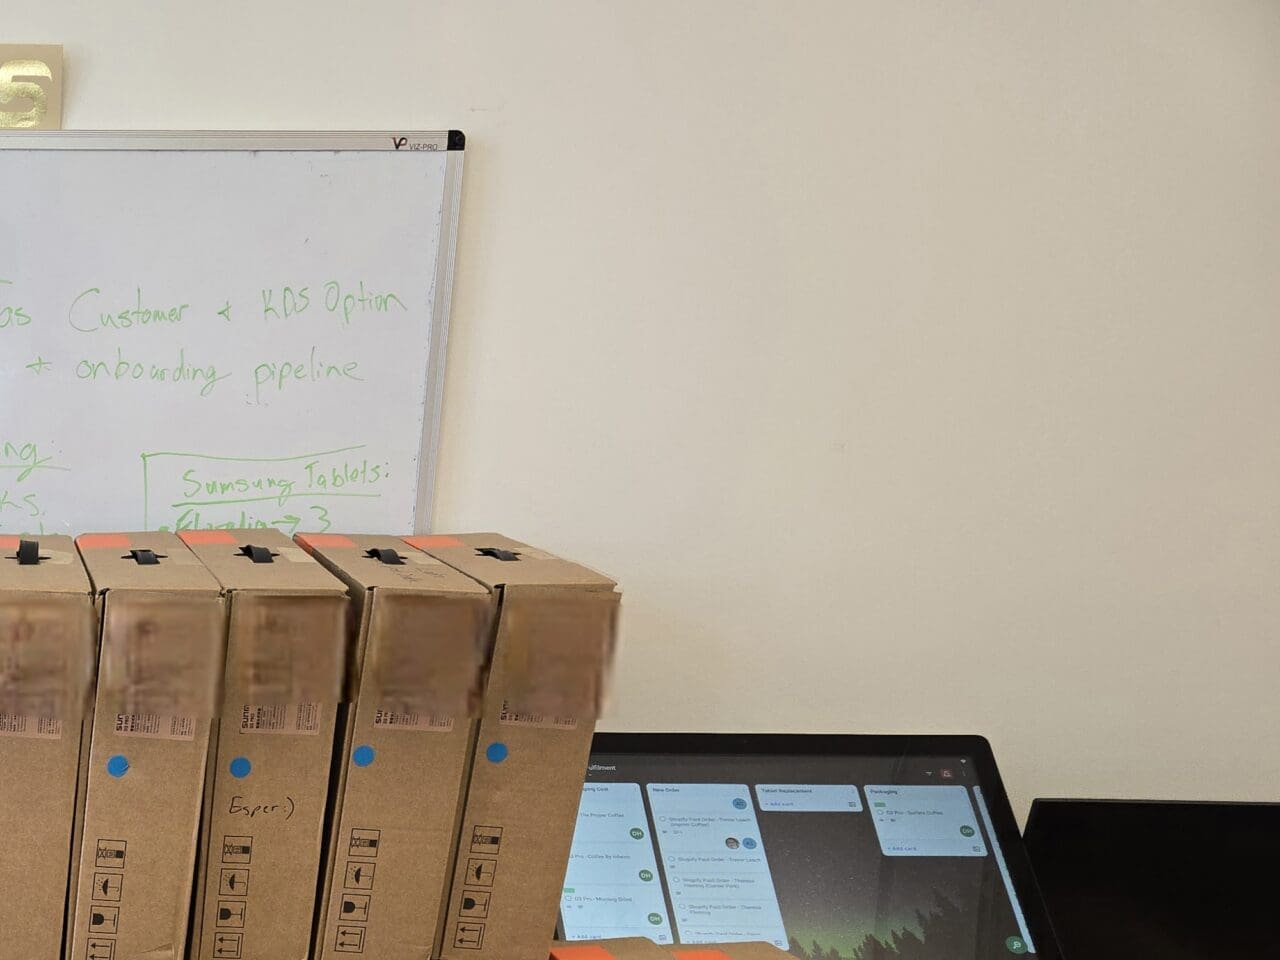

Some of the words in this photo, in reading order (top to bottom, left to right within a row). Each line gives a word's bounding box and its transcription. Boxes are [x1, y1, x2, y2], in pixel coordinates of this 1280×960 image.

[409, 144, 438, 152] VIZ-PRO
[69, 287, 189, 332] Customer
[324, 280, 408, 325] Option
[76, 347, 232, 397] onboarding
[254, 345, 366, 405] pipeline
[182, 469, 296, 506] Samsung
[229, 795, 279, 818] Esper
